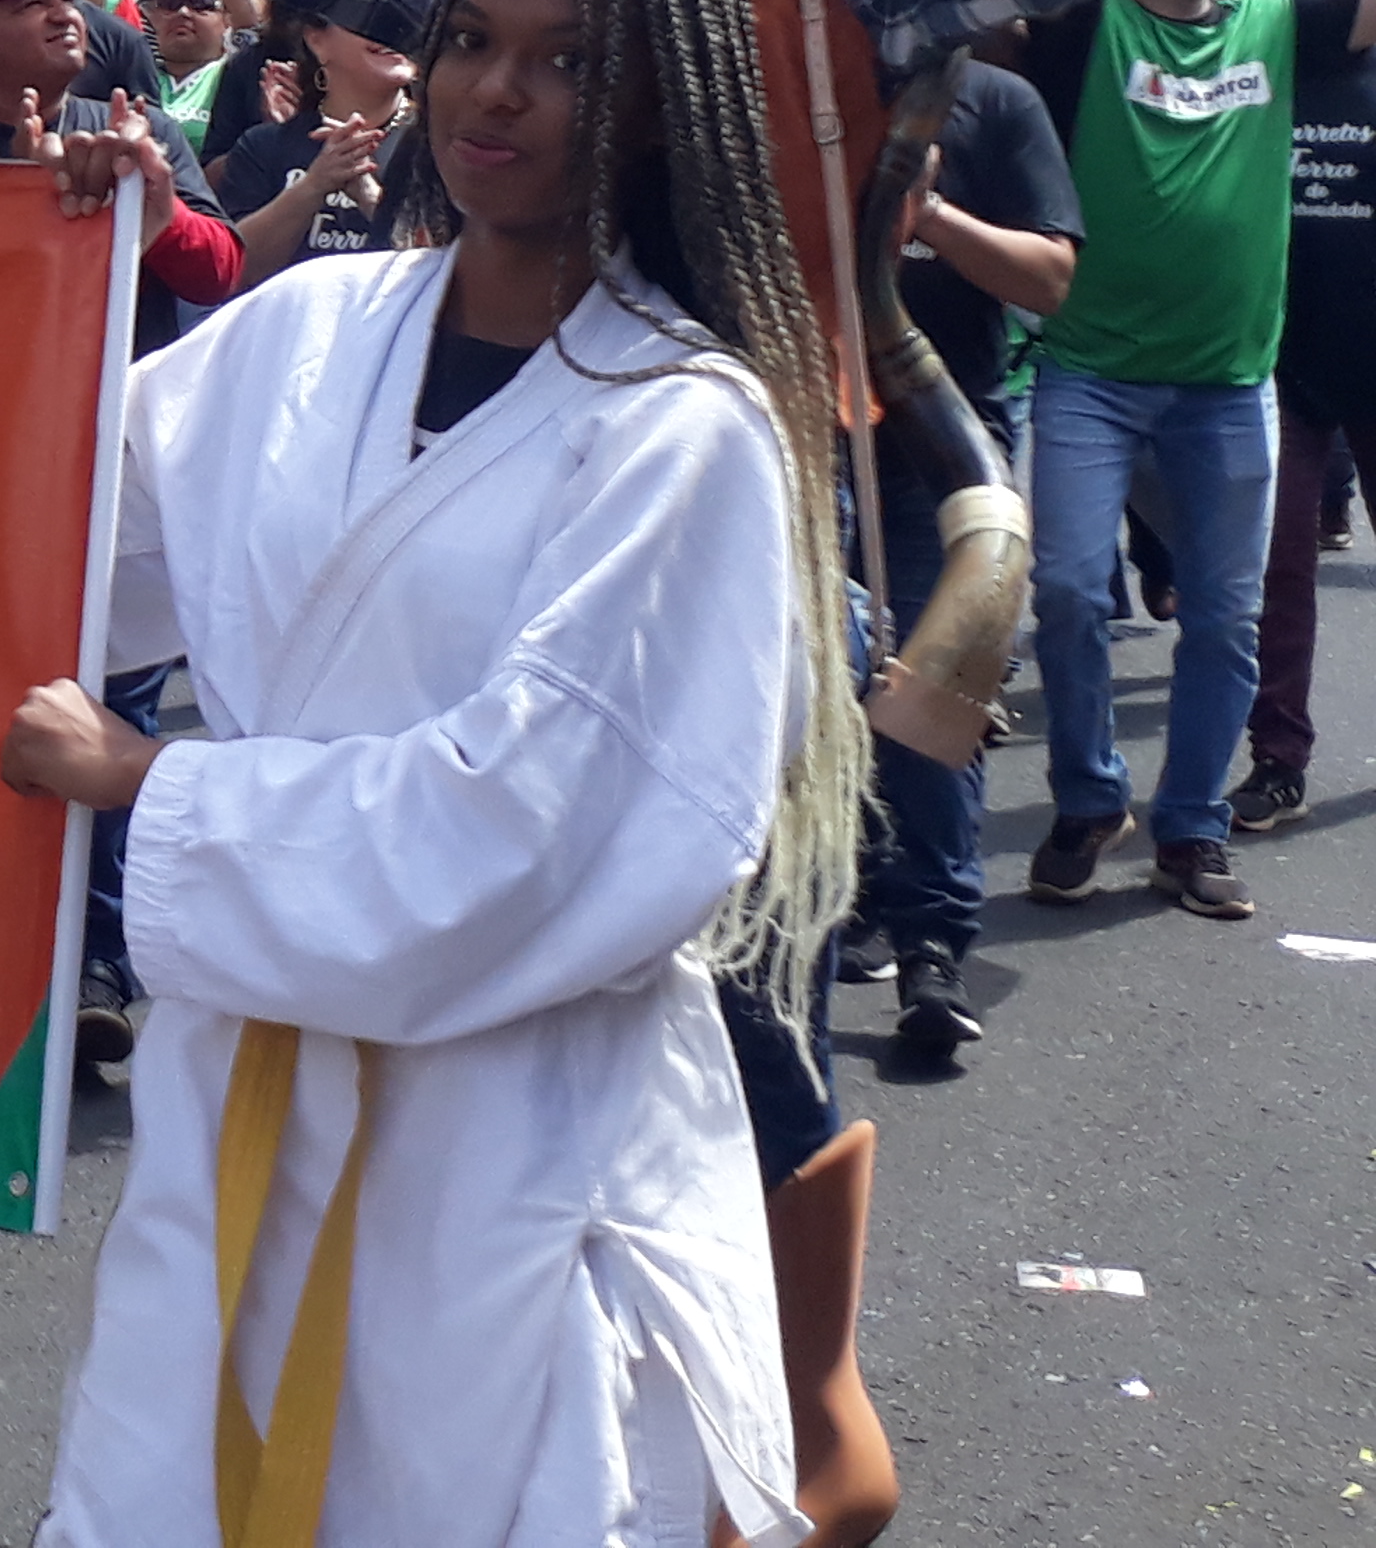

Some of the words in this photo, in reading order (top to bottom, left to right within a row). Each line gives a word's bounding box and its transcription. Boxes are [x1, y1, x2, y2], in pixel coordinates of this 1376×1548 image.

[1292, 122, 1375, 144] arretos
[1289, 148, 1359, 179] Terra
[1305, 182, 1329, 200] de
